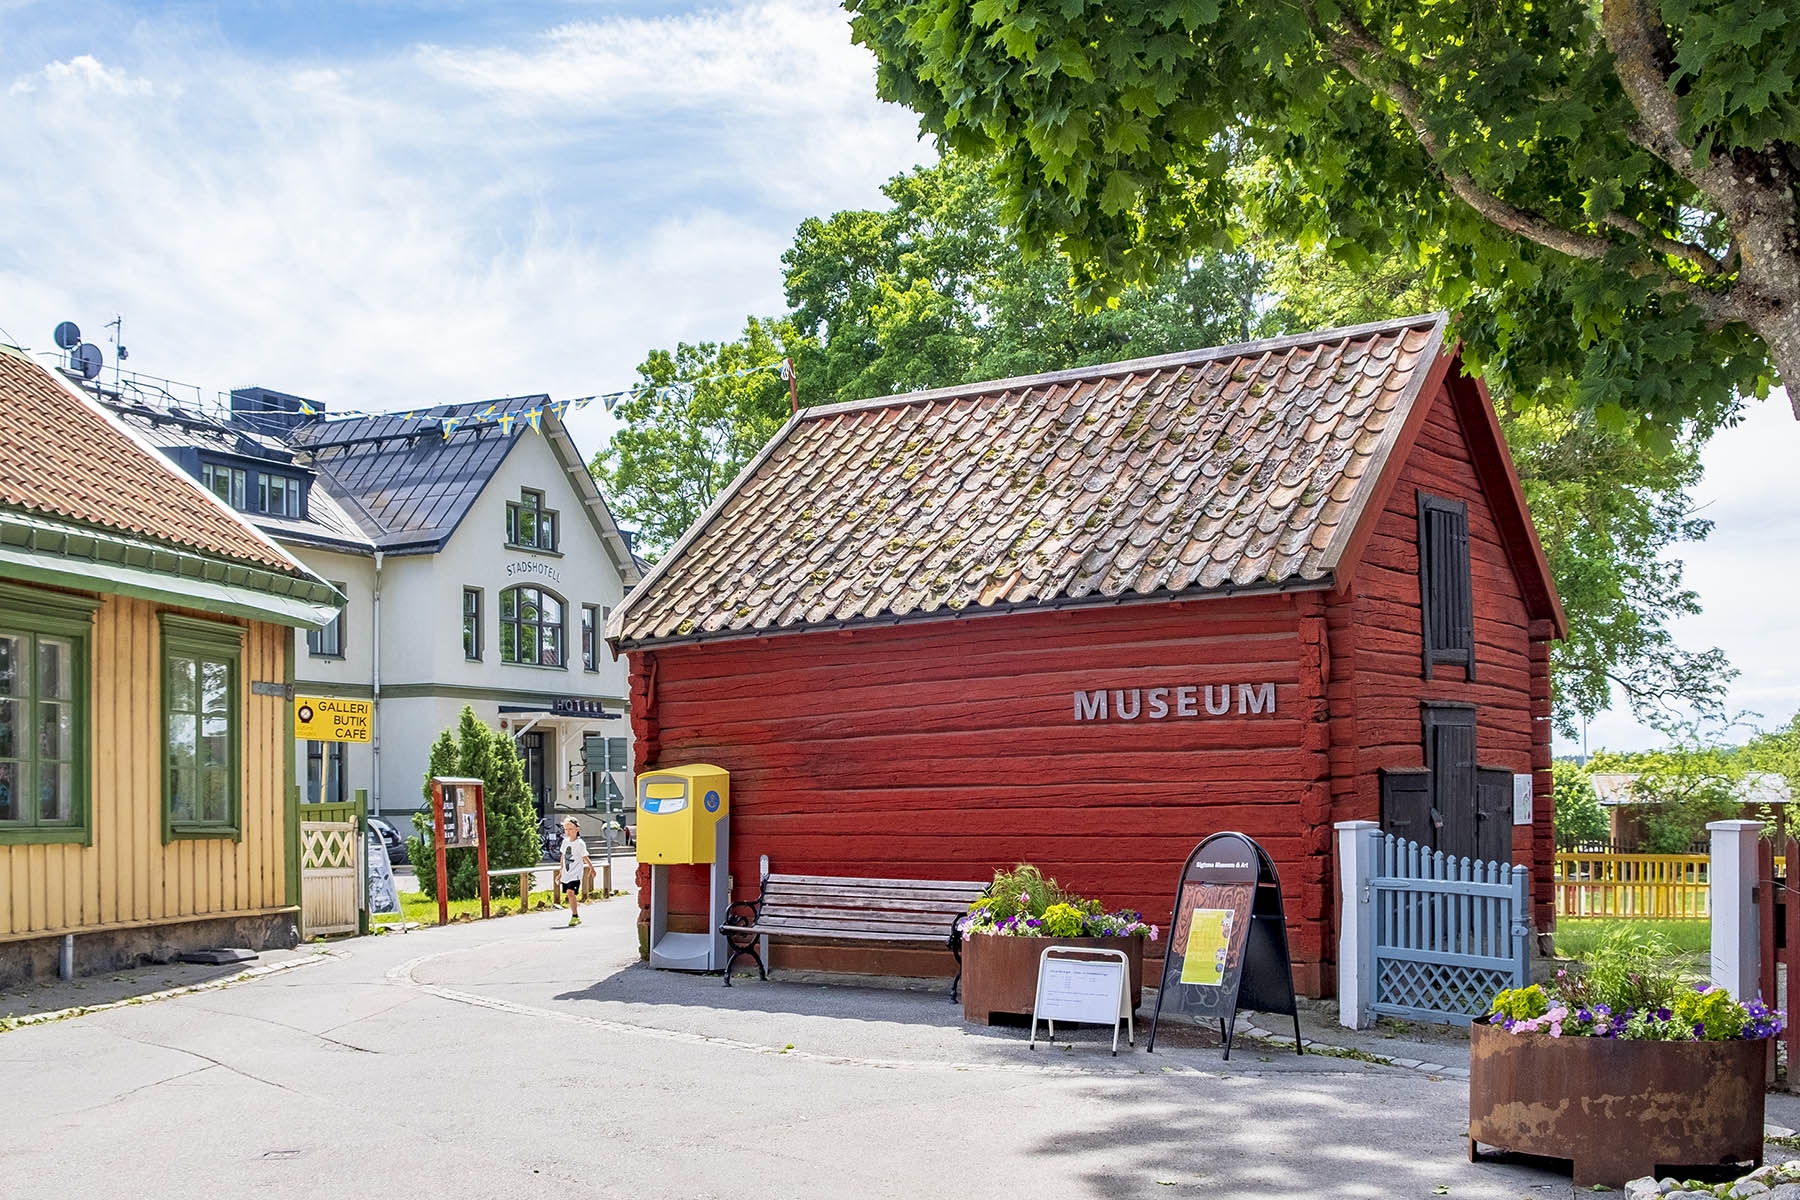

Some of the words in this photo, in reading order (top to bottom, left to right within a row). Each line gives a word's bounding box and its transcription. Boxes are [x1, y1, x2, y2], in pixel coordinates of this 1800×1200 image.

[506, 561, 560, 583] STADSHOTELL
[318, 701, 368, 714] GALLERI
[554, 699, 605, 713] HOTELL
[1073, 682, 1276, 721] MUSEUM
[333, 715, 367, 727] BUTIK
[335, 727, 366, 739] CAFÉ
